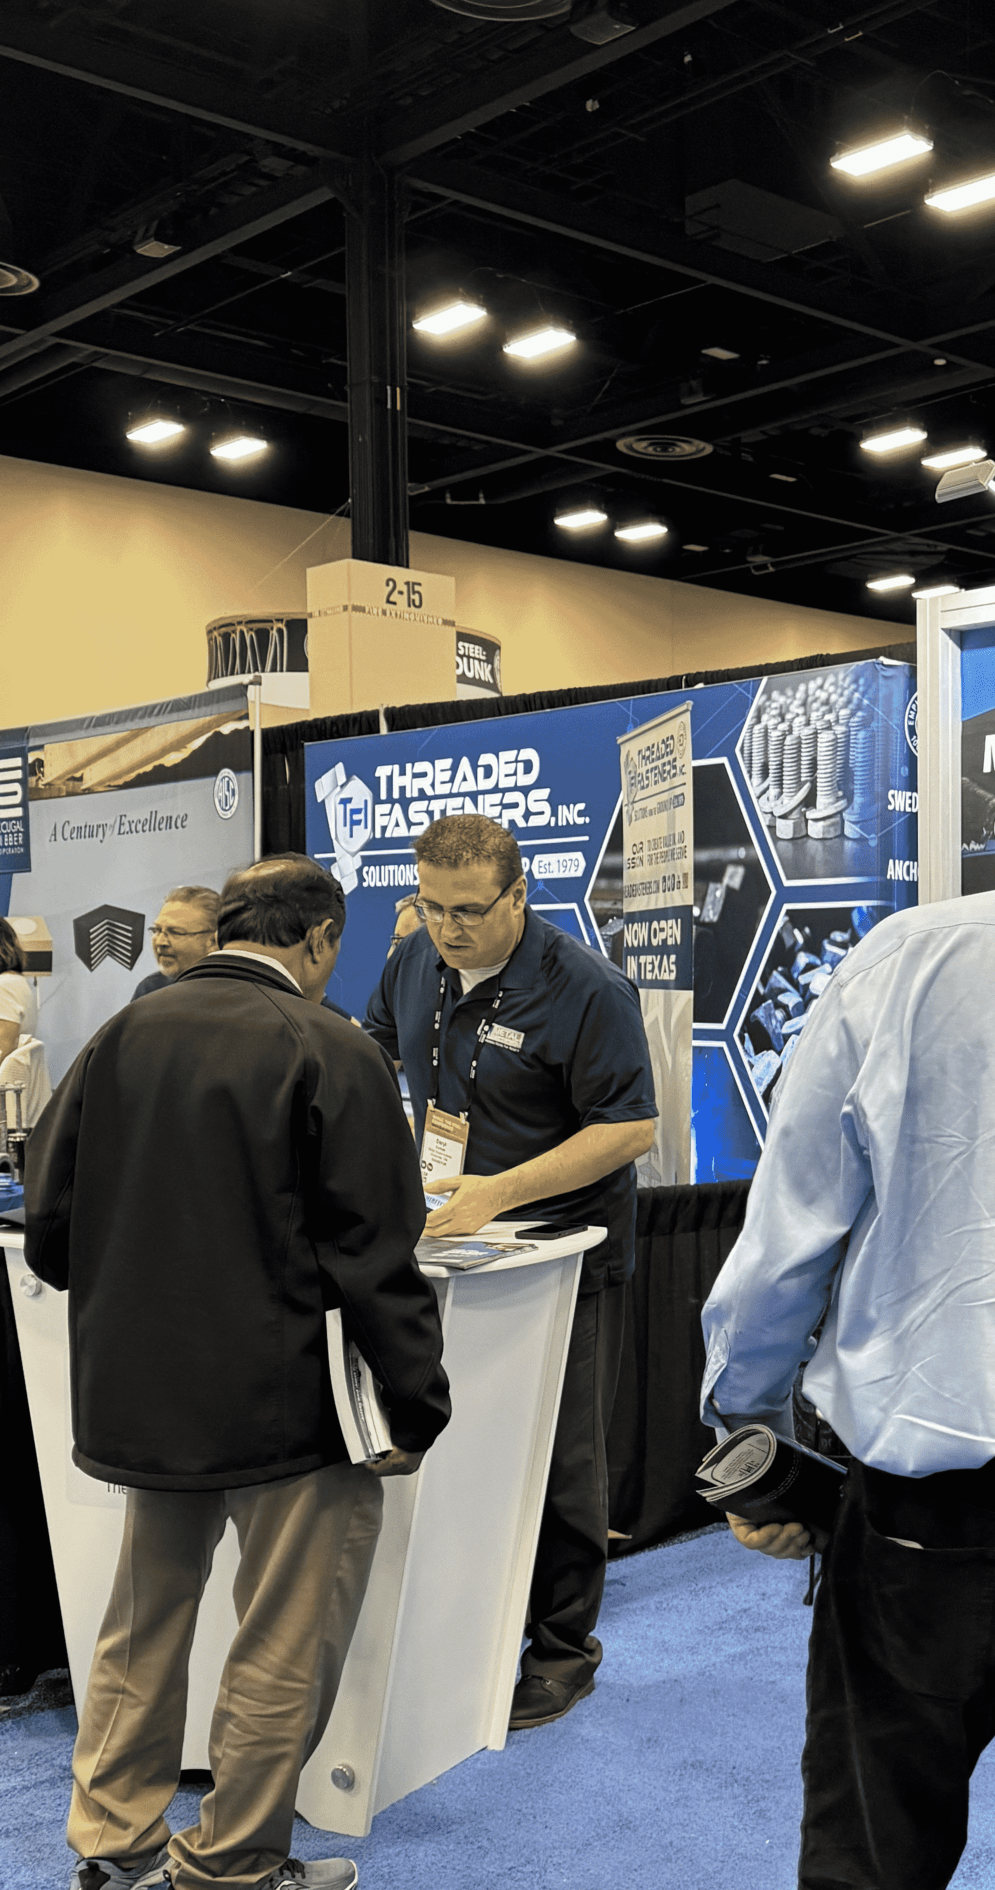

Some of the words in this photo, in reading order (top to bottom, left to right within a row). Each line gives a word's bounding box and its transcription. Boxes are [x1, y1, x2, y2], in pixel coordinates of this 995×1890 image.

[385, 577, 423, 609] 2-15
[374, 748, 541, 800] THREADED
[49, 821, 57, 842] A
[61, 820, 108, 844] Century
[117, 810, 188, 836] Excellence
[338, 797, 368, 838] TFI
[557, 803, 591, 826] INC.
[362, 864, 420, 887] SOLUTIONS
[537, 860, 553, 874] Est.
[557, 858, 580, 873] 1979
[886, 859, 918, 882] ANCH
[624, 921, 649, 948] NOW
[650, 918, 682, 947] OPEN
[626, 955, 638, 980] IN
[638, 954, 677, 980] TEXAS
